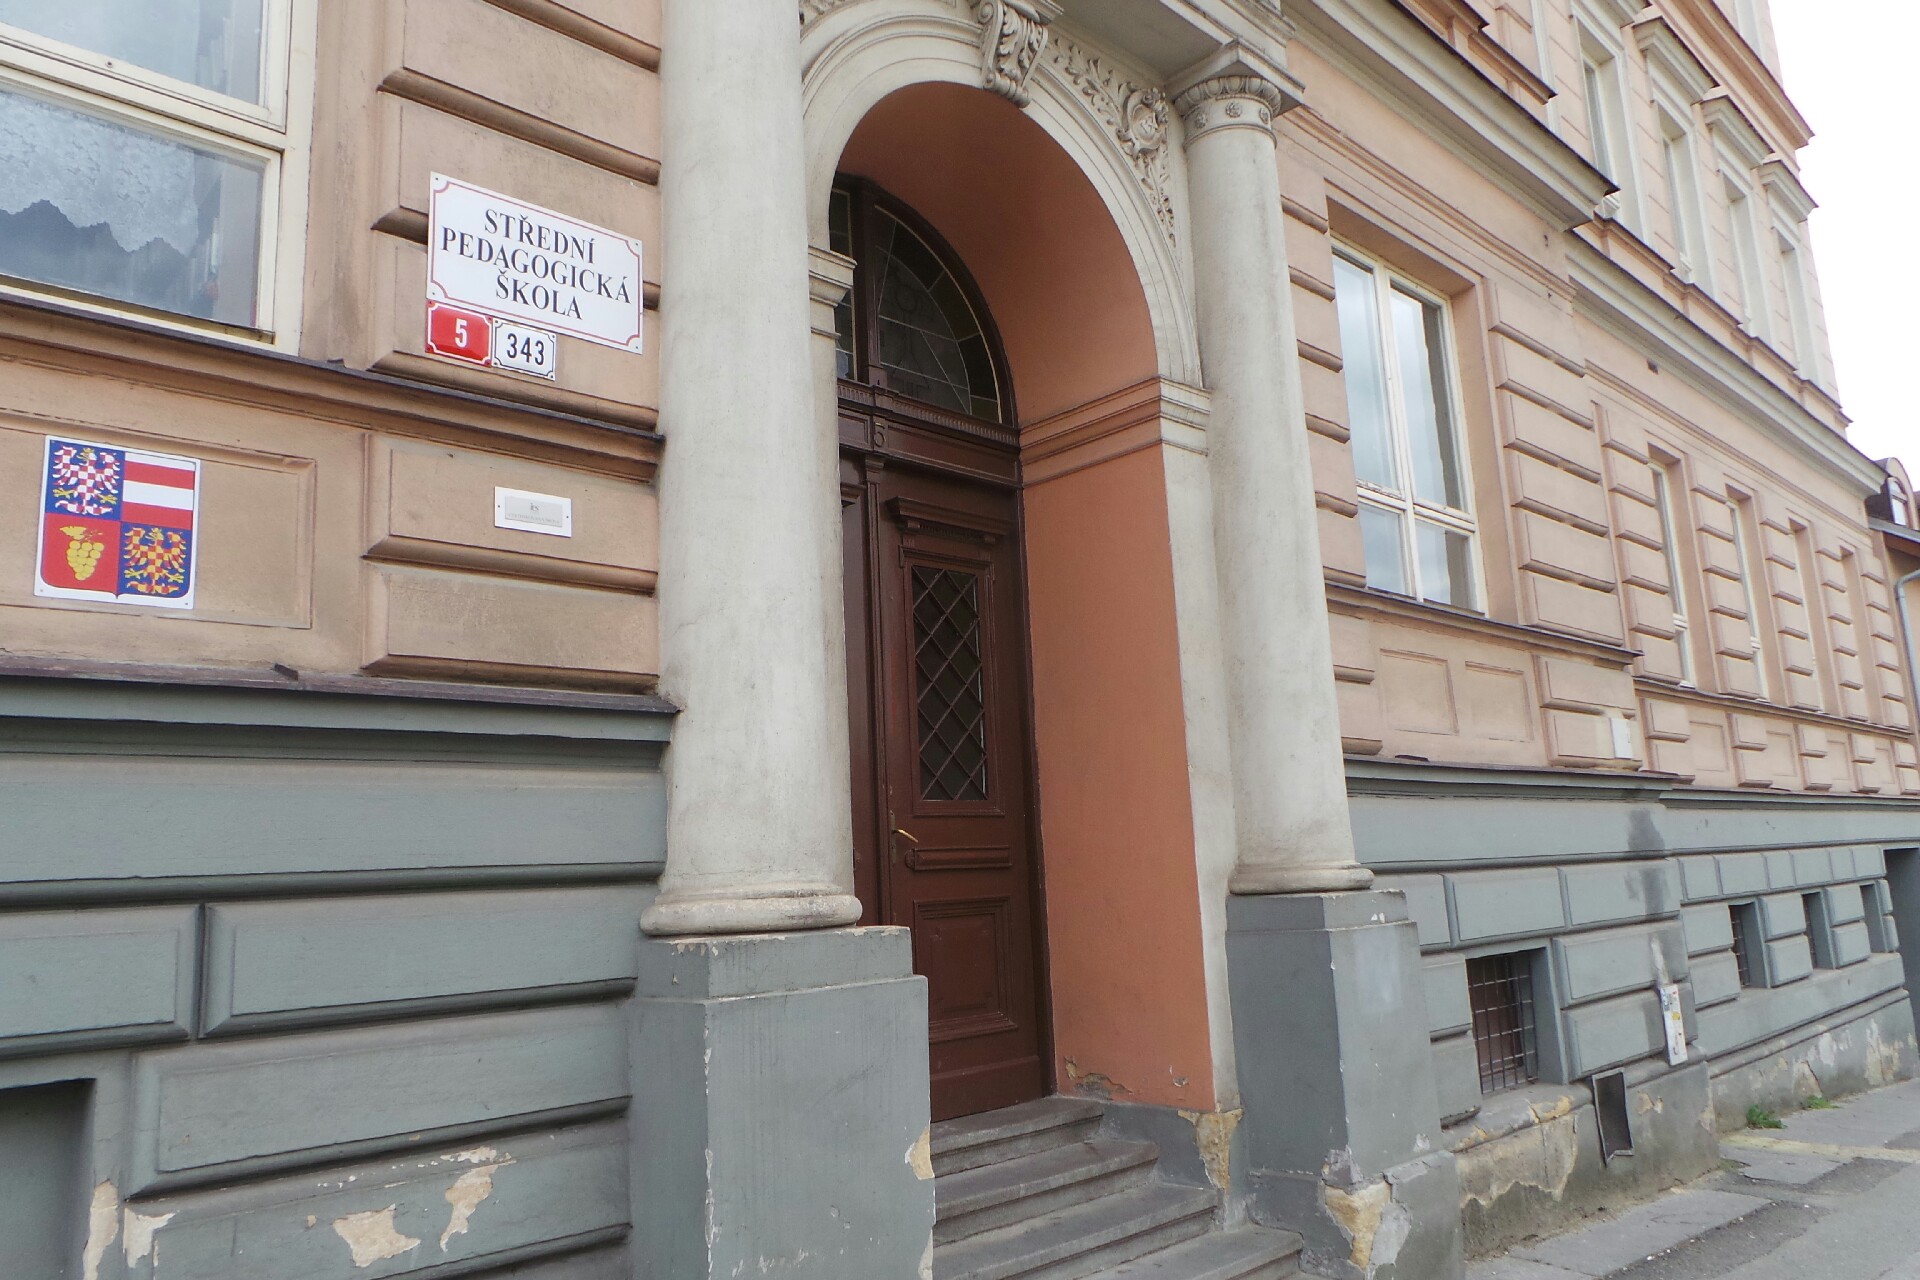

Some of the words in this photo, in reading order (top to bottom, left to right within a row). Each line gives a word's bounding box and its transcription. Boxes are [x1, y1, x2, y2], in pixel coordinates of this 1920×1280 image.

[484, 209, 594, 264] STŘEDNÍ
[441, 226, 631, 304] PEDAGOGICKÁ
[496, 268, 582, 320] ŠKOLA
[454, 318, 468, 348] 5
[507, 333, 545, 366] 343
[873, 421, 887, 448] 5
